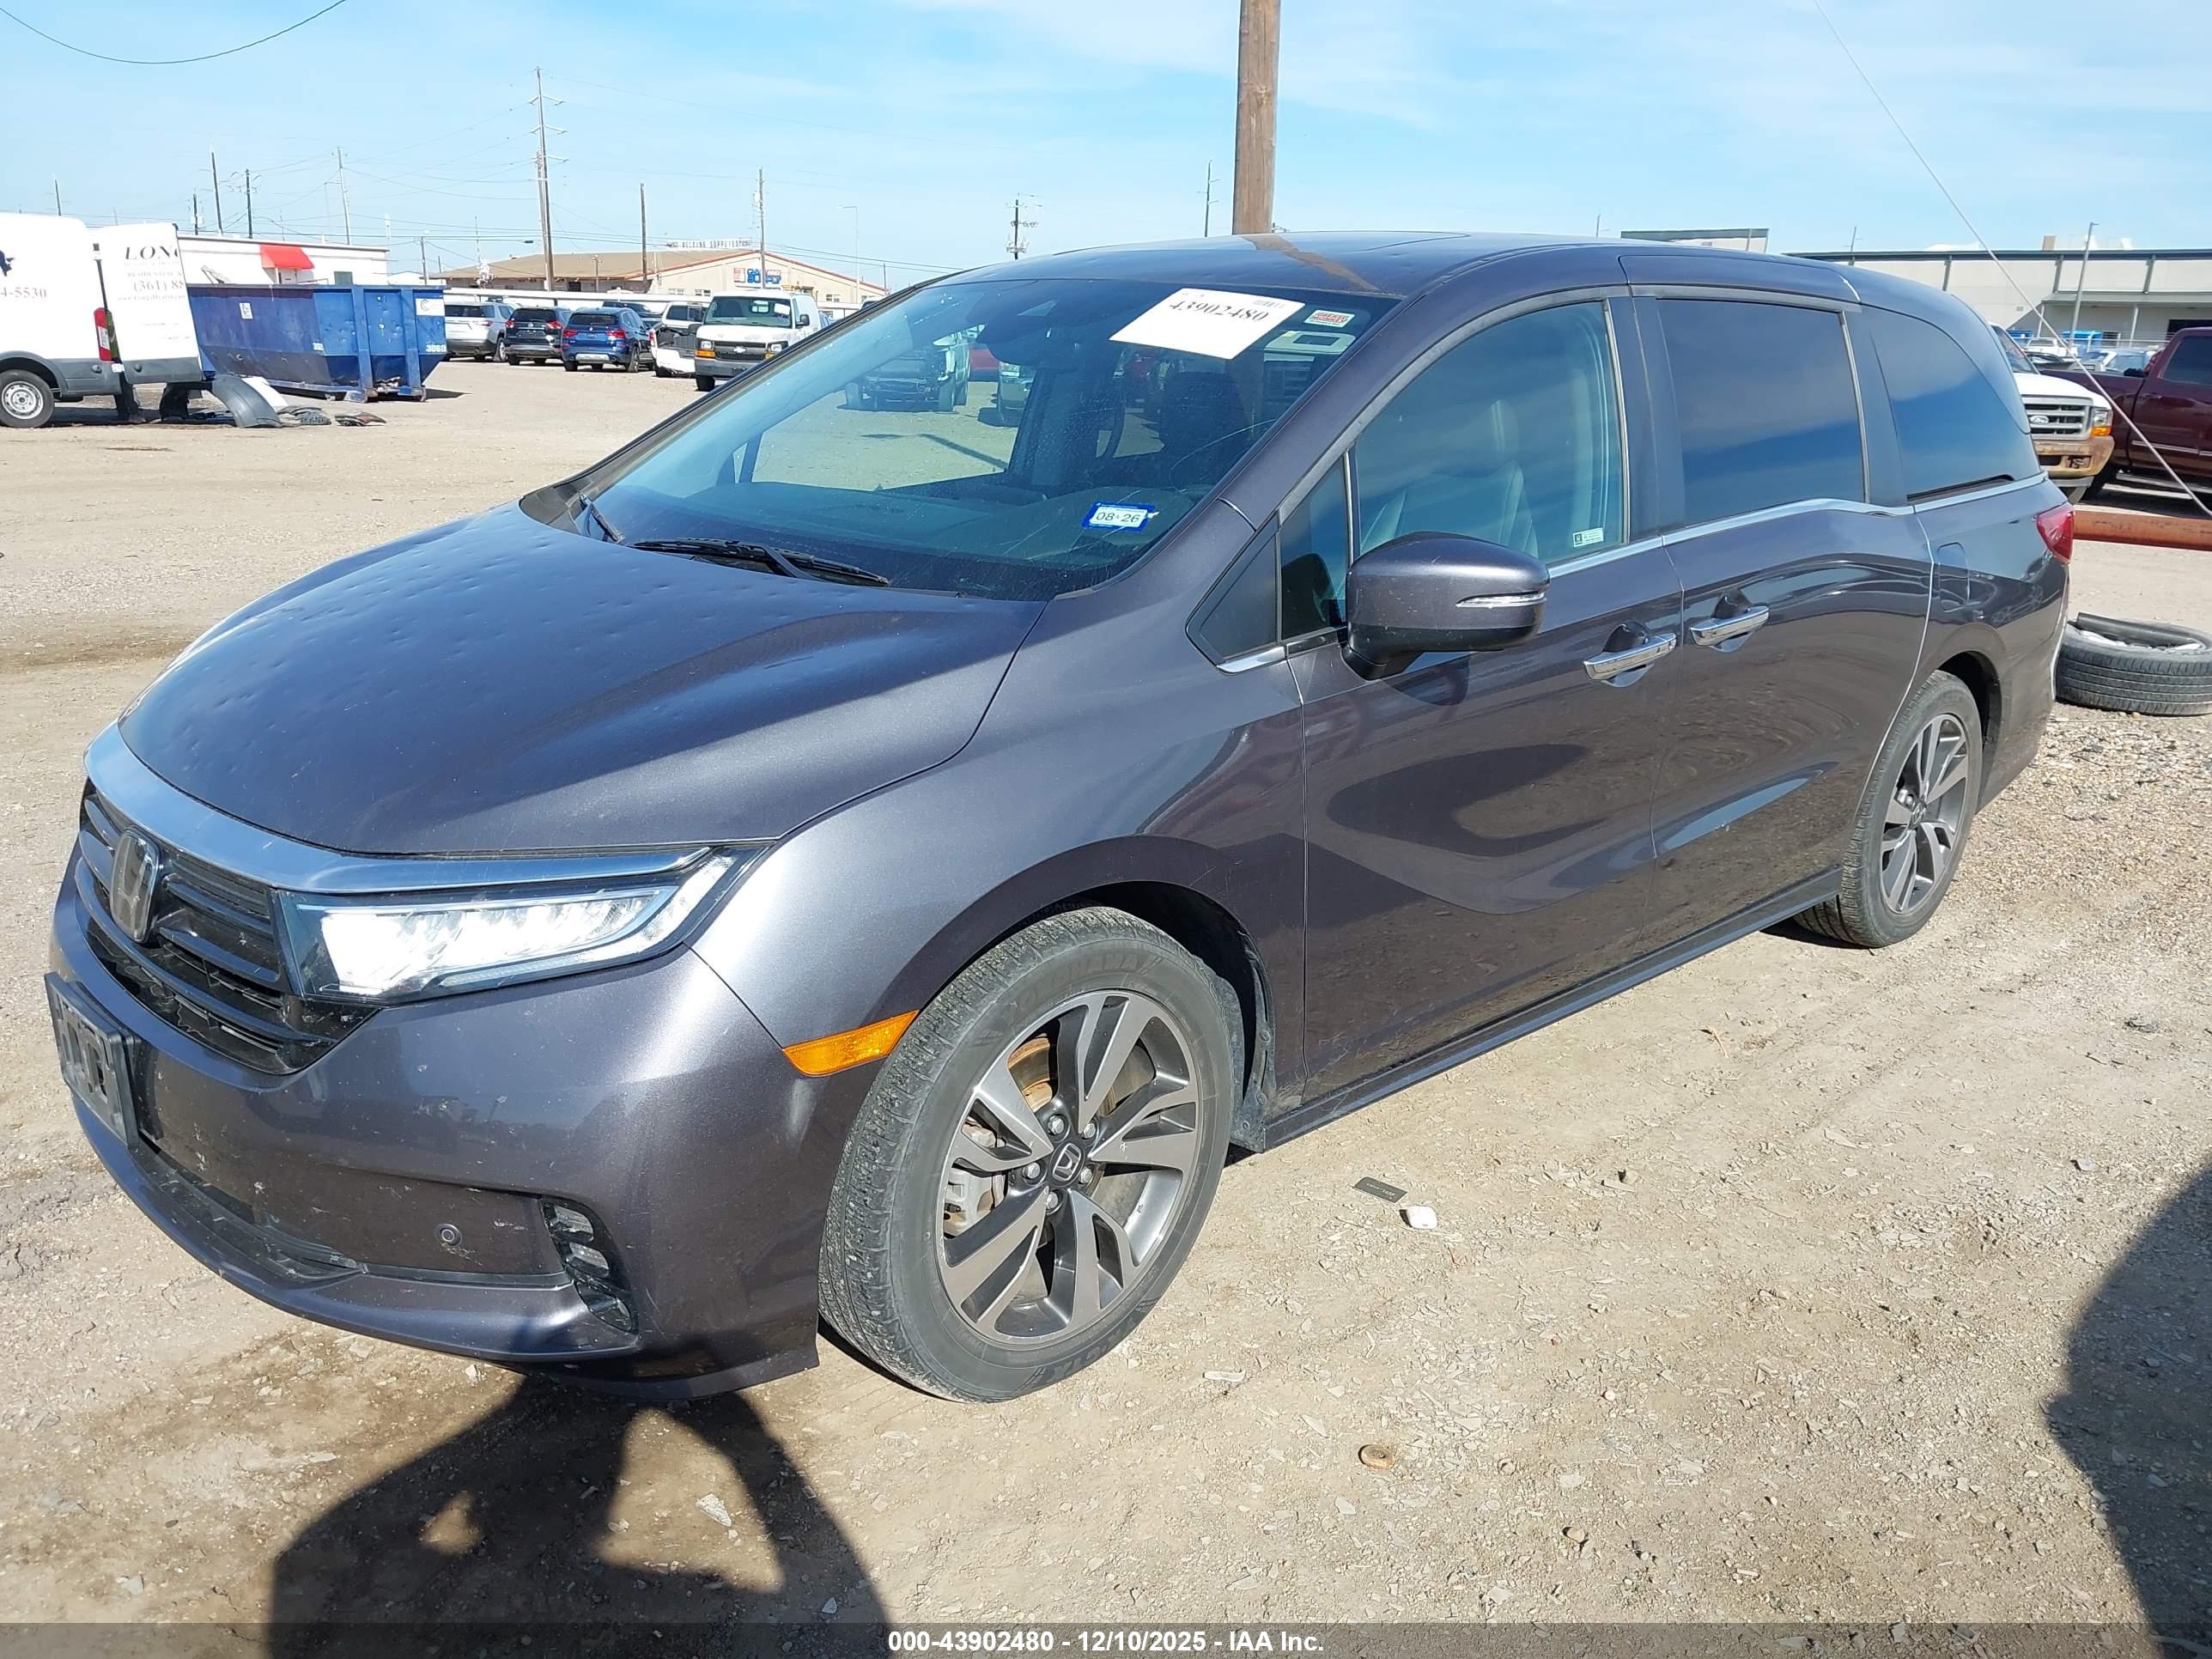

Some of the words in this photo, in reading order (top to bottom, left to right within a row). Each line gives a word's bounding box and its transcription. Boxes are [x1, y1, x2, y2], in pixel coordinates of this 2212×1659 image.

[1169, 301, 1270, 322] 43902480
[1096, 512, 1115, 522] 08
[1120, 514, 1141, 523] 26
